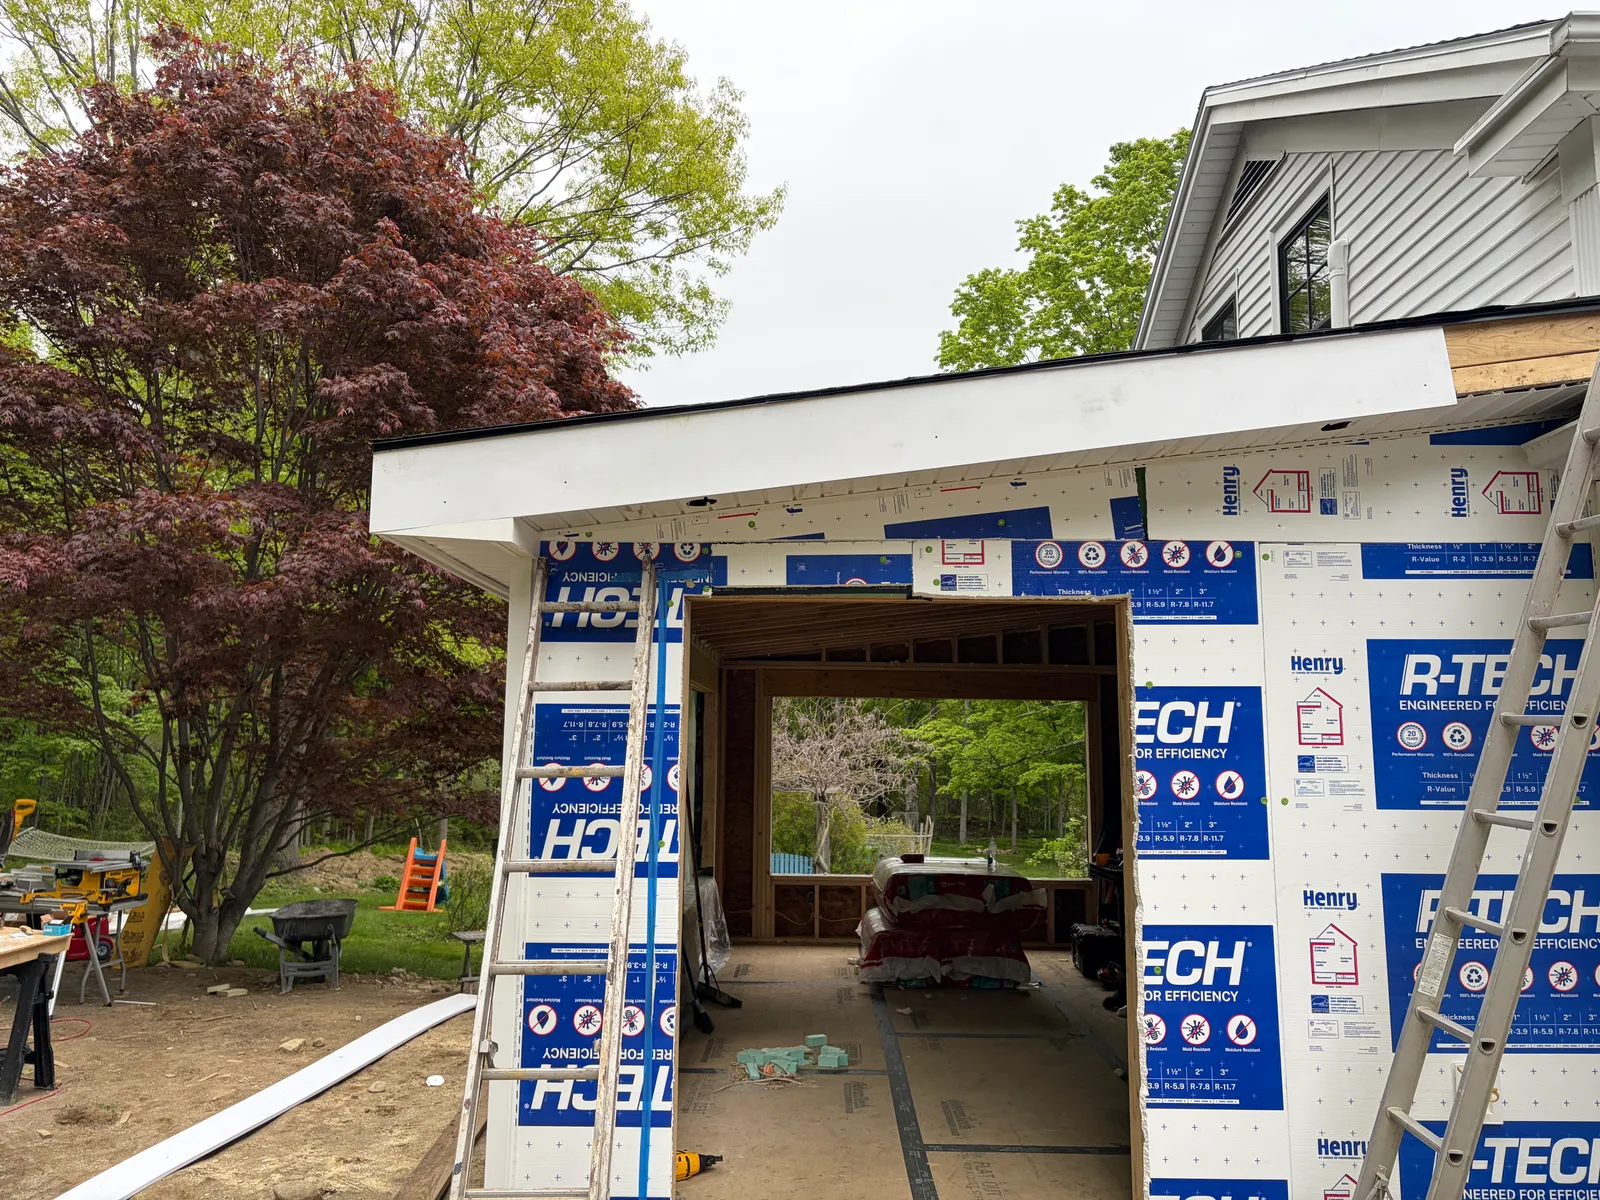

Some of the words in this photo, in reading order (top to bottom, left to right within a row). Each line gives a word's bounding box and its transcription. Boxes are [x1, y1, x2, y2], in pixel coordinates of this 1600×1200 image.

[1223, 466, 1240, 515] Henry
[1451, 468, 1468, 517] Henry
[1291, 656, 1344, 675] Henry
[1400, 700, 1481, 711] ENGINEERED
[1135, 701, 1235, 744] ECH
[1136, 749, 1153, 759] OR
[1156, 749, 1228, 759] EFFICIENCY
[552, 803, 622, 814] EFFICIENCY
[1303, 890, 1357, 911] Henry
[1142, 941, 1246, 985] ECH
[1144, 991, 1162, 1001] OR
[1165, 991, 1239, 1001] EFFICIENCY
[543, 1048, 600, 1059] FICIENCY
[1463, 1189, 1516, 1200] NEERED
[1520, 1189, 1545, 1200] FOR
